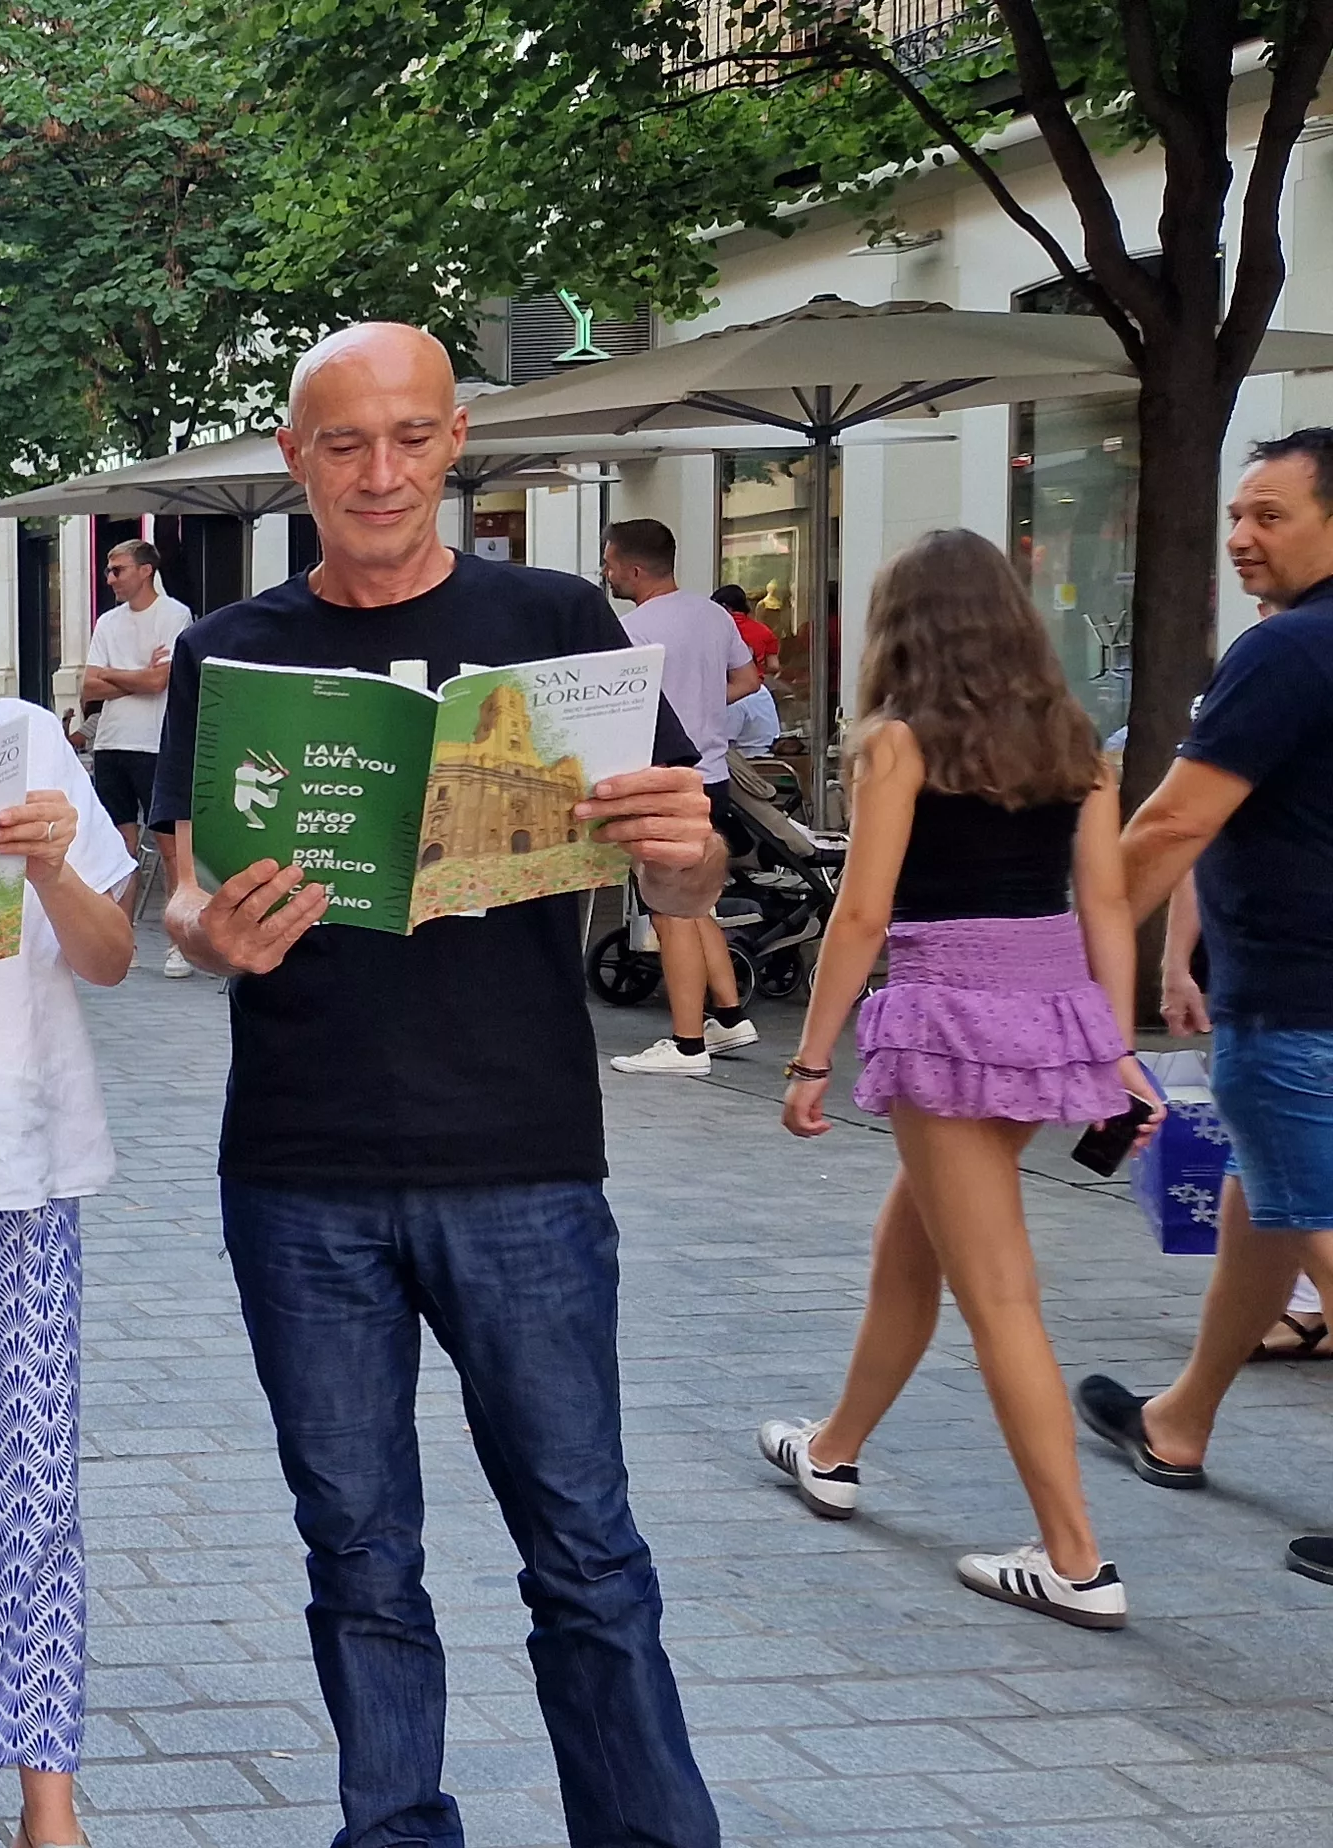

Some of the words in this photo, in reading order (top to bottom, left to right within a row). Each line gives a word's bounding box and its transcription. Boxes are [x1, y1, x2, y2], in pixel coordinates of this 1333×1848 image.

[619, 665, 648, 677] 2025
[534, 668, 581, 689] SAN
[533, 678, 648, 707] LORENZO
[305, 744, 331, 756] LA
[333, 745, 357, 758] LA
[303, 756, 351, 769] LOVE
[357, 758, 396, 775] YOU
[300, 783, 364, 796] VICCO
[297, 809, 356, 824] MÄGO
[295, 823, 319, 834] DE
[323, 824, 350, 834] OZ
[293, 849, 334, 860] DON
[292, 859, 376, 874] PATRICIO
